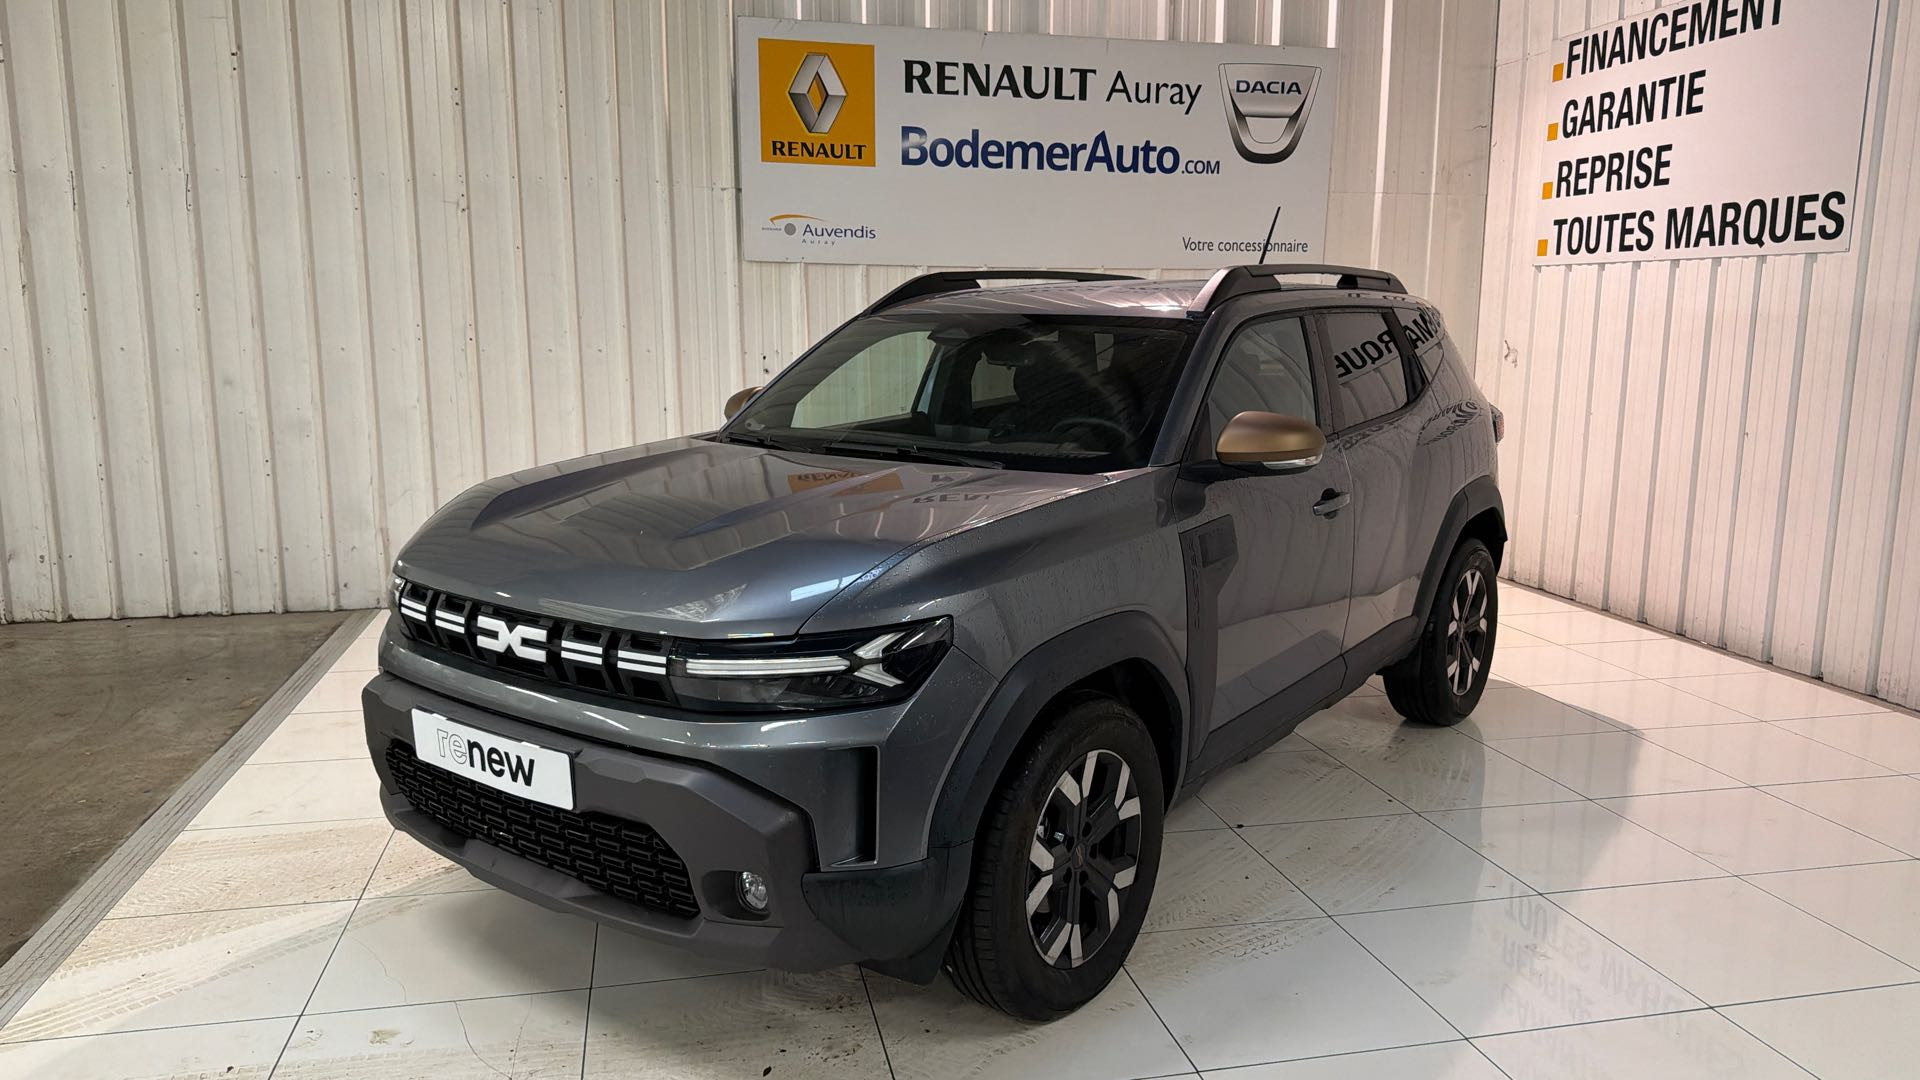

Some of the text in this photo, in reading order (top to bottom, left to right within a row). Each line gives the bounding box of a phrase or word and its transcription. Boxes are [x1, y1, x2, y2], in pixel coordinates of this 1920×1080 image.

[903, 59, 1202, 115] RENAULT Auray
[1235, 80, 1302, 95] DACIA
[1562, 69, 1707, 139] GARANTIE
[772, 140, 867, 160] RENAULT
[1555, 143, 1673, 198] REPRISE
[802, 223, 876, 239] Auvendis
[1182, 236, 1214, 252] Votre
[1553, 190, 1846, 256] TOUTES MARQUES
[436, 728, 535, 788] renew
